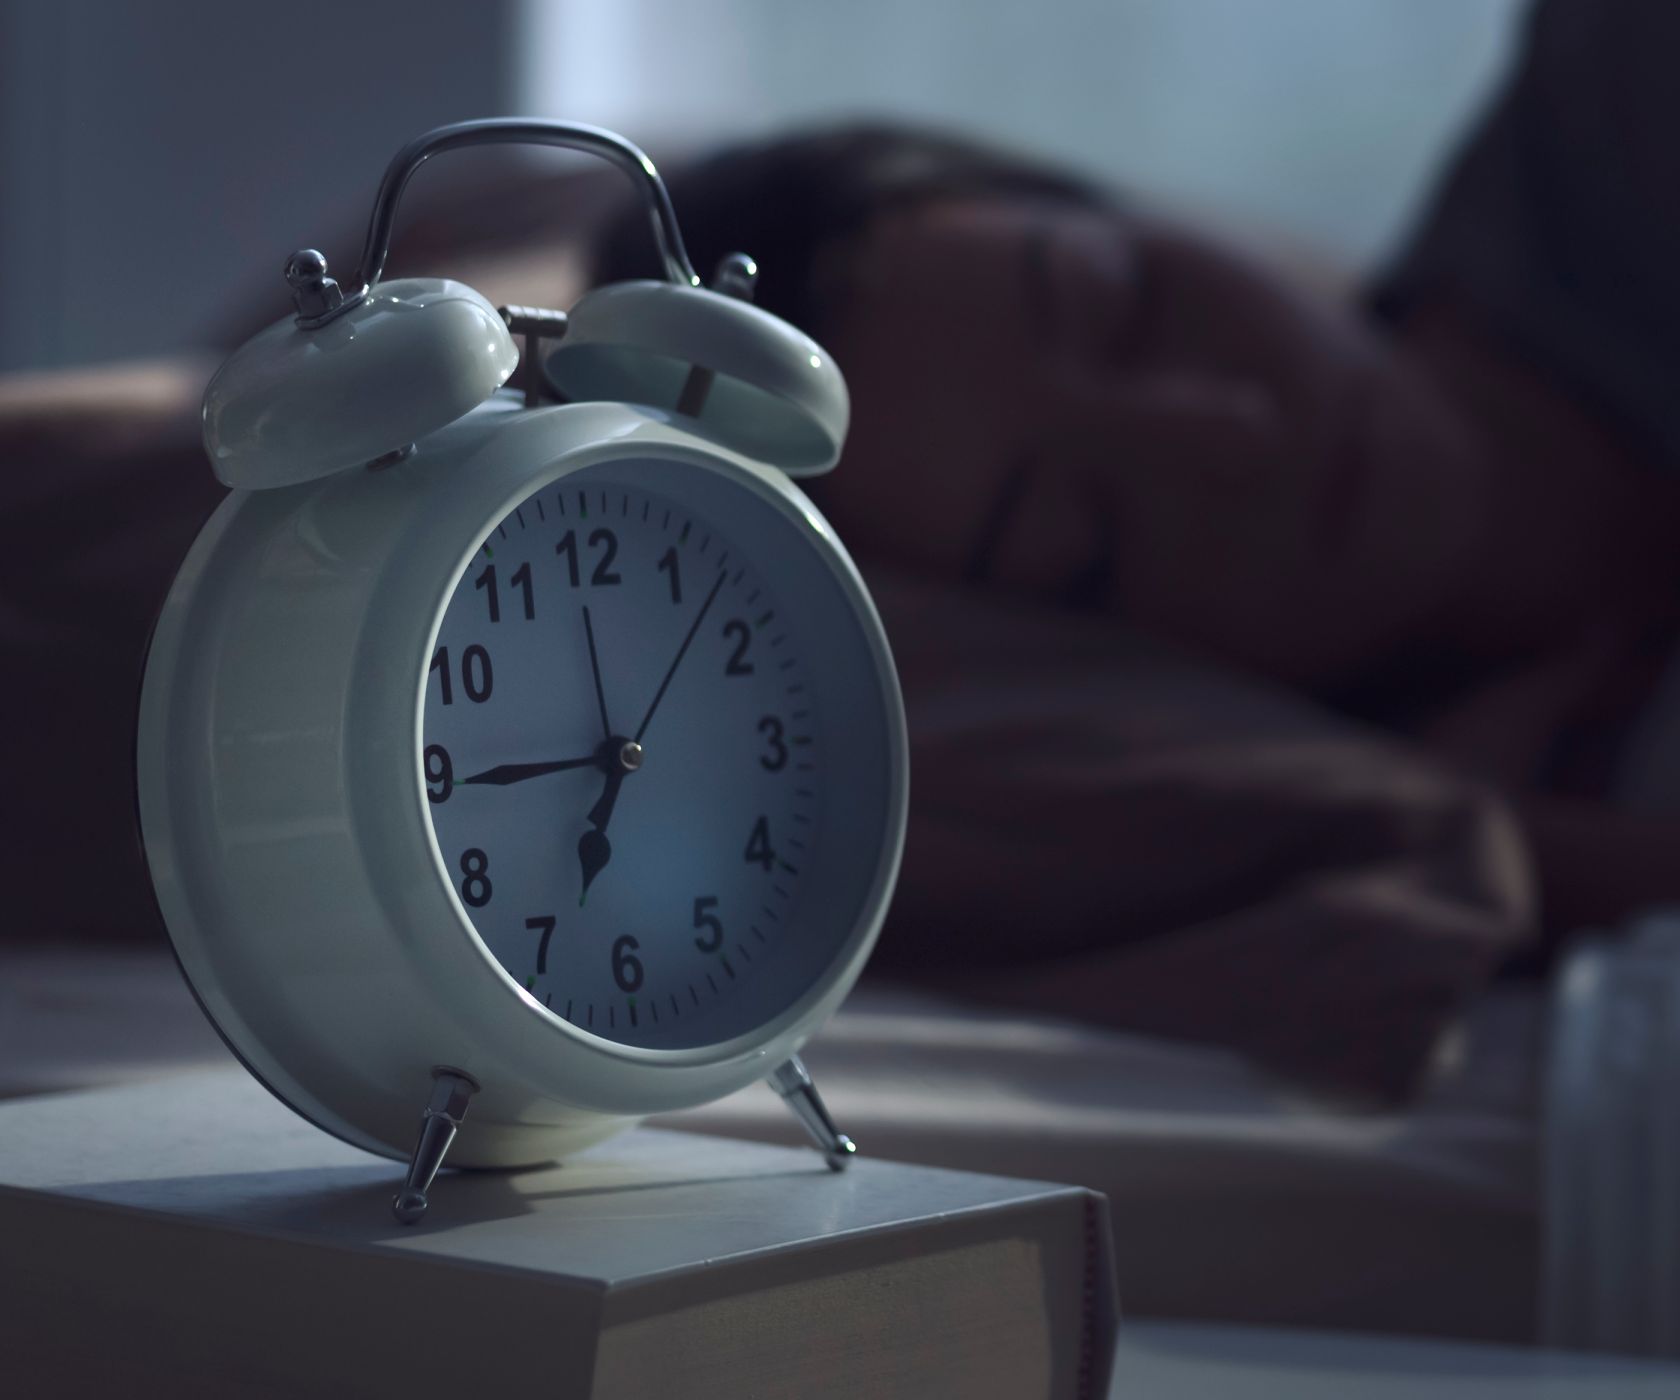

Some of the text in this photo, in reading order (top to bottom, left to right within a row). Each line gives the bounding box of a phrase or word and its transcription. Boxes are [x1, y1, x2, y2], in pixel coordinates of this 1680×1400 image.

[555, 528, 621, 588] 12
[657, 546, 682, 604] 1
[475, 562, 535, 622] 11
[429, 644, 494, 705] 10
[722, 619, 754, 676] 2
[757, 715, 788, 772] 3
[423, 744, 453, 803] 9
[745, 816, 774, 871] 4
[459, 847, 493, 907] 8
[525, 916, 556, 975] 7
[693, 895, 723, 954] 5
[611, 935, 644, 993] 6
